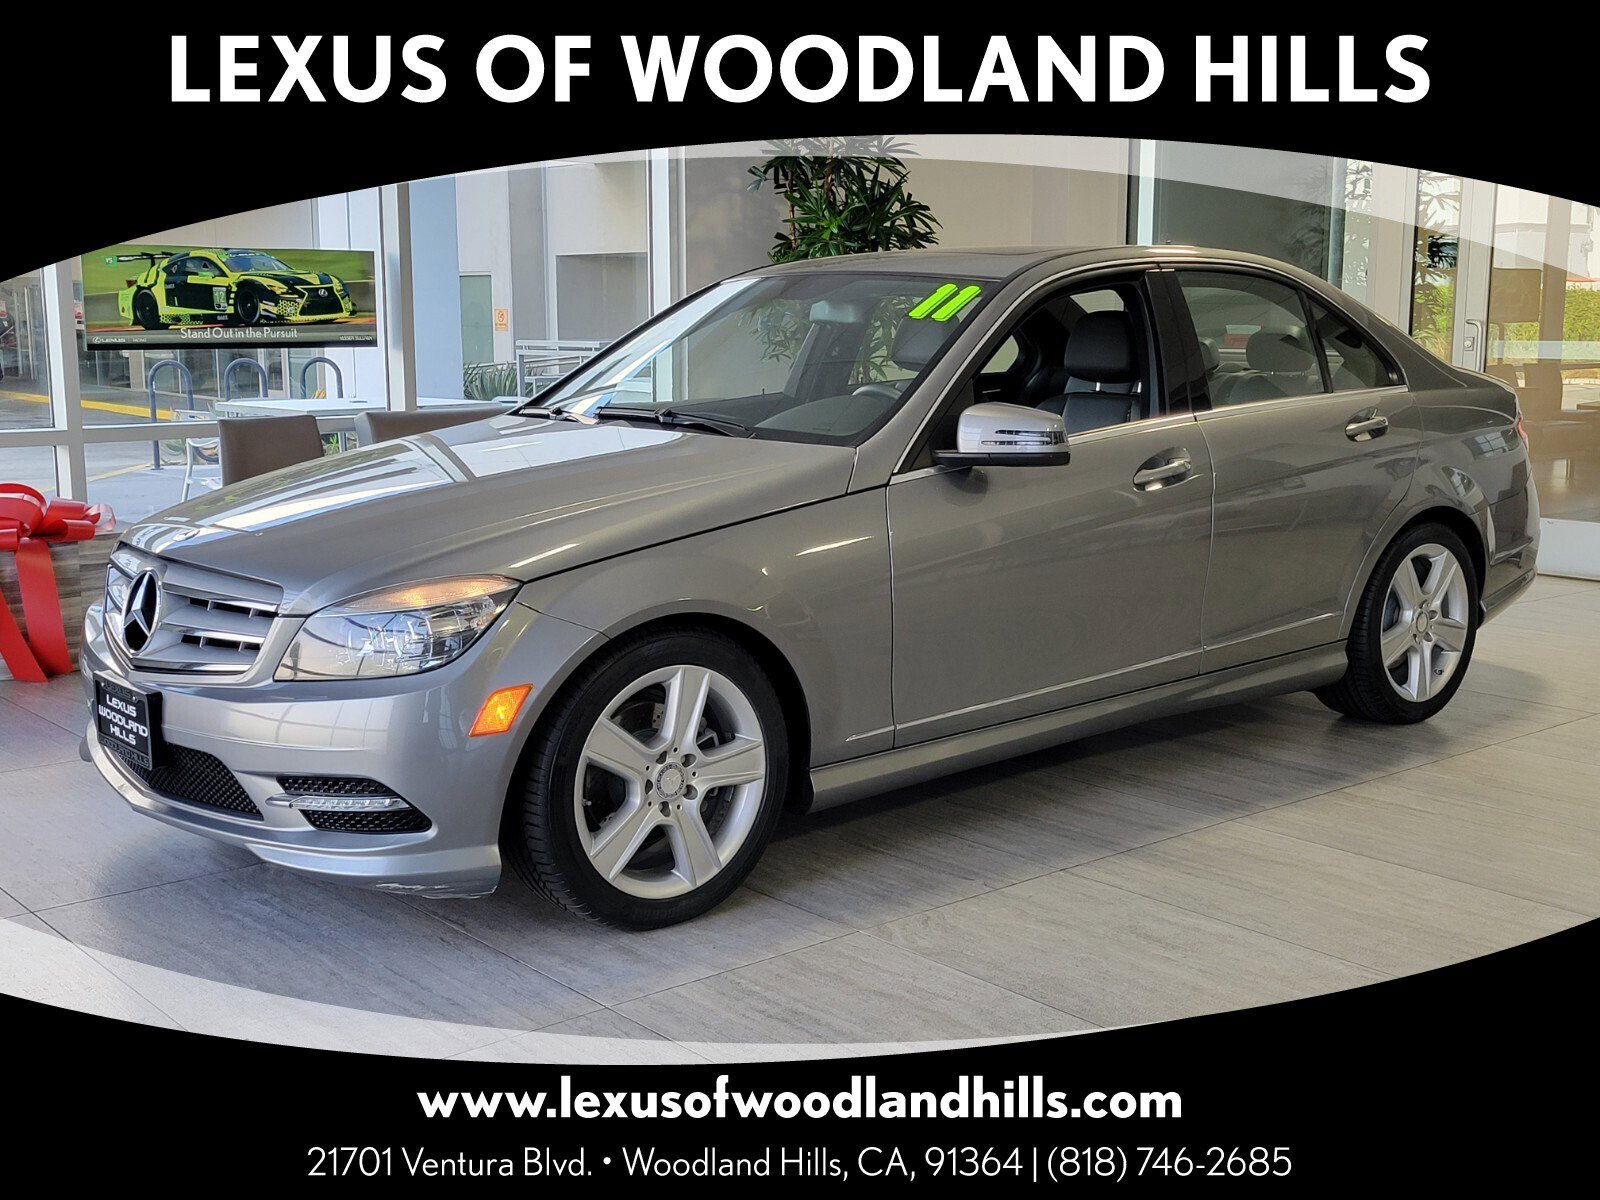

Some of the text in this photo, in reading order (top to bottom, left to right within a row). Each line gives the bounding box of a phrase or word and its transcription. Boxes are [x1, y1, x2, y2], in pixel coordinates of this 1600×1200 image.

[215, 290, 225, 303] 12
[909, 283, 981, 321] 11
[180, 327, 298, 339] Stand Out in the Pursuit
[106, 694, 137, 717] LEXUS
[98, 704, 148, 737] WOODLAND
[109, 723, 136, 746] HILLS
